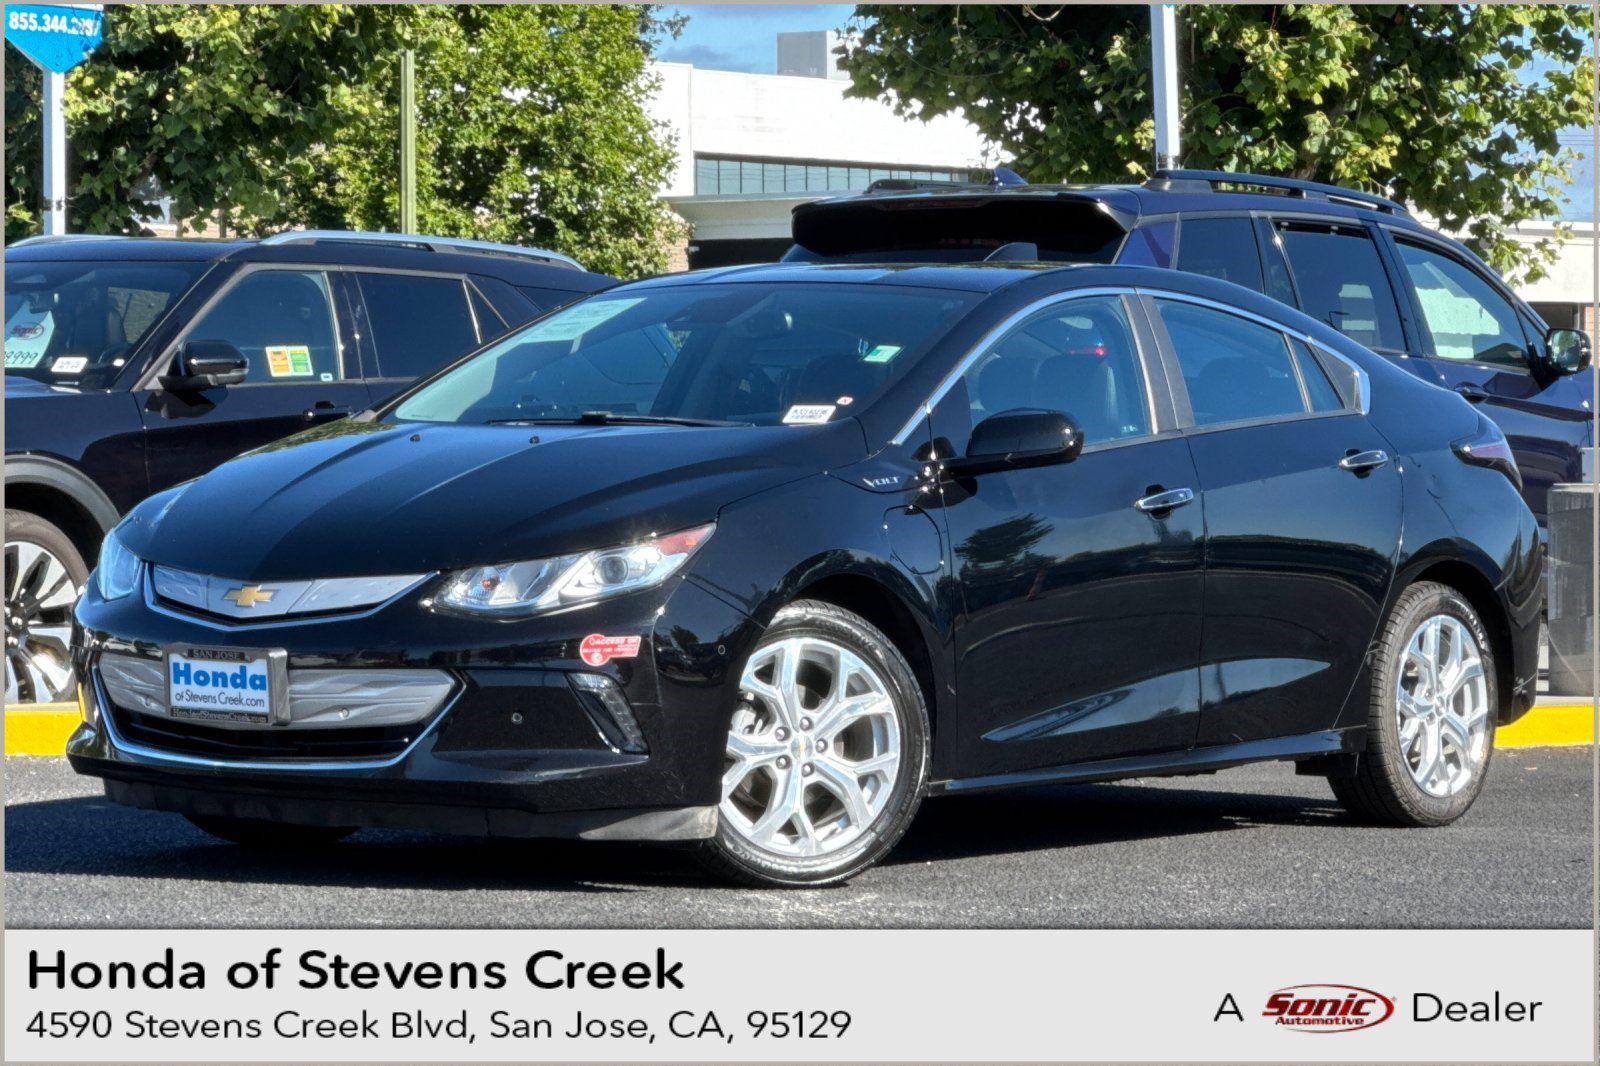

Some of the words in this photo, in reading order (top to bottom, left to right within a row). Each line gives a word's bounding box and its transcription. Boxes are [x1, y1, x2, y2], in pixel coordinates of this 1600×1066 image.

[862, 476, 899, 488] VOLT
[193, 650, 213, 659] SAN
[216, 651, 240, 660] JOSE
[172, 662, 267, 691] Honda
